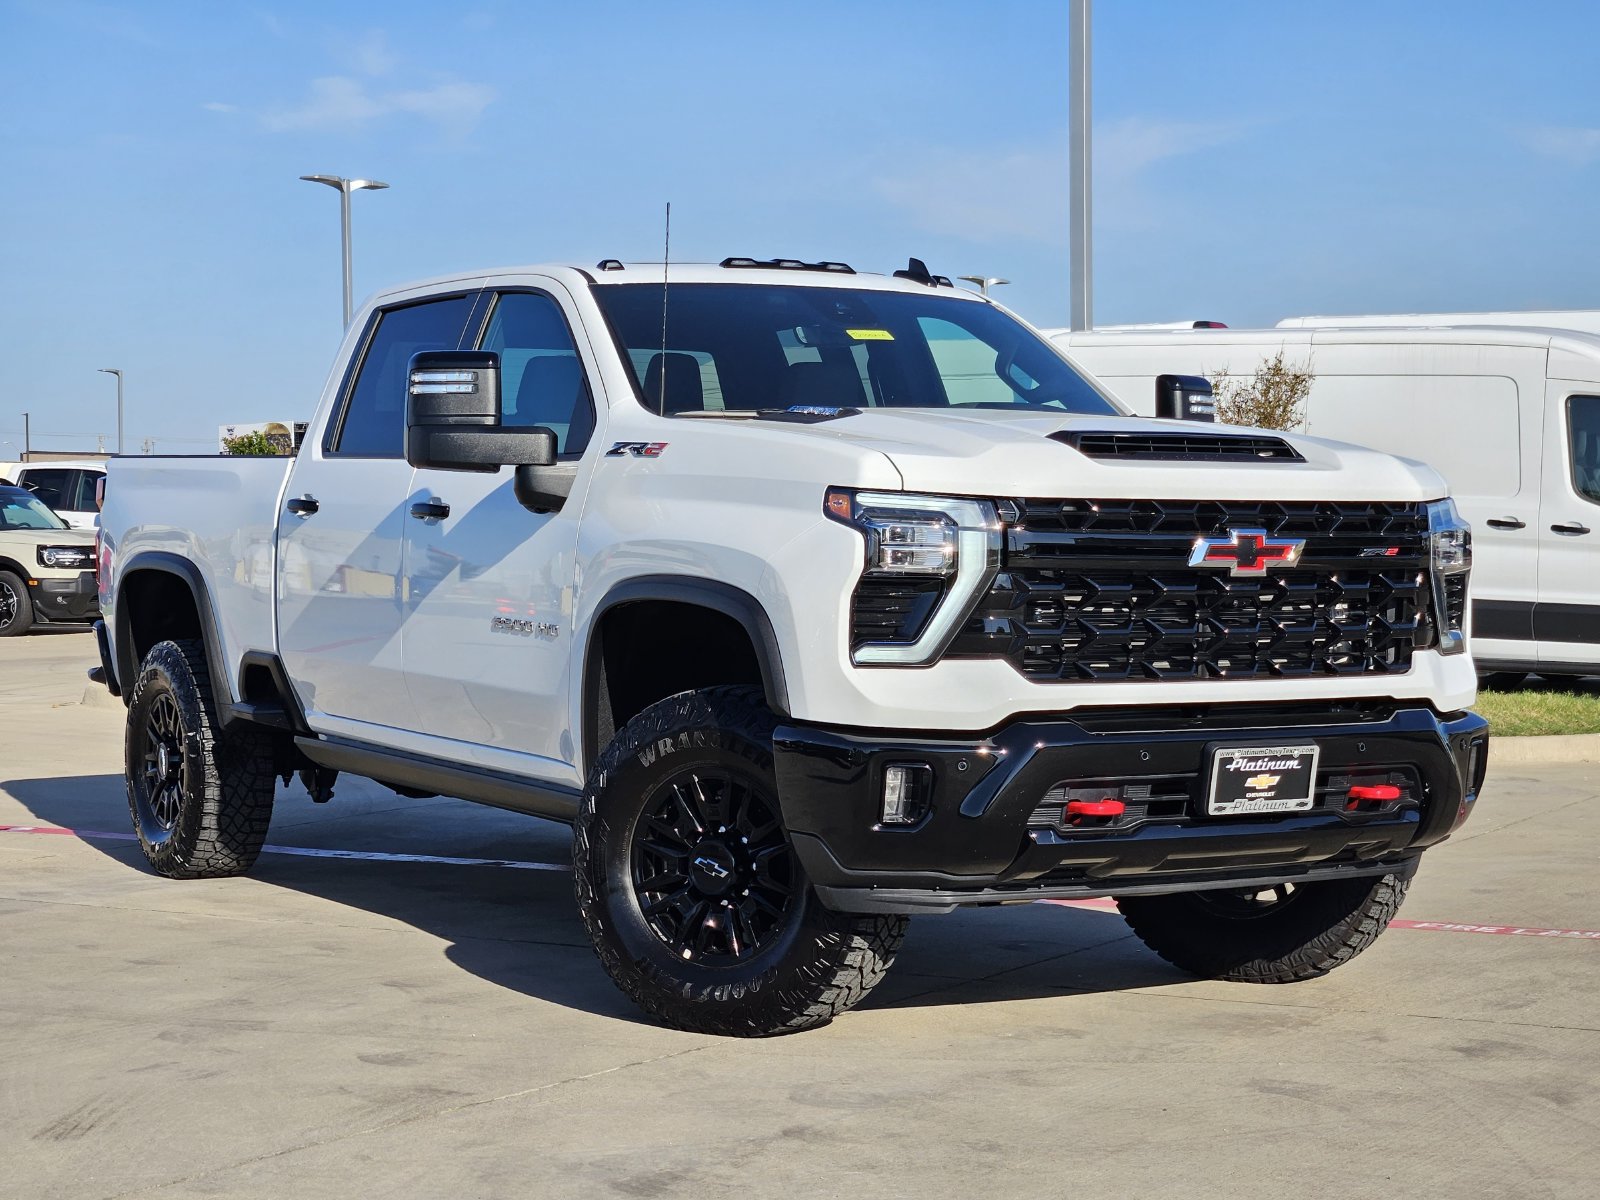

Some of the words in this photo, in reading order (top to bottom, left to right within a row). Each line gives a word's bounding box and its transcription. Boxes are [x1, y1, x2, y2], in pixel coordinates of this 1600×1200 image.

[604, 441, 669, 458] ZR2
[1358, 547, 1399, 557] ZR2
[1219, 748, 1315, 757] wwwPlatinumChevyTexa.com
[1226, 758, 1301, 772] Platinum
[1230, 798, 1291, 812] Platinum
[1413, 922, 1506, 933] FIRE
